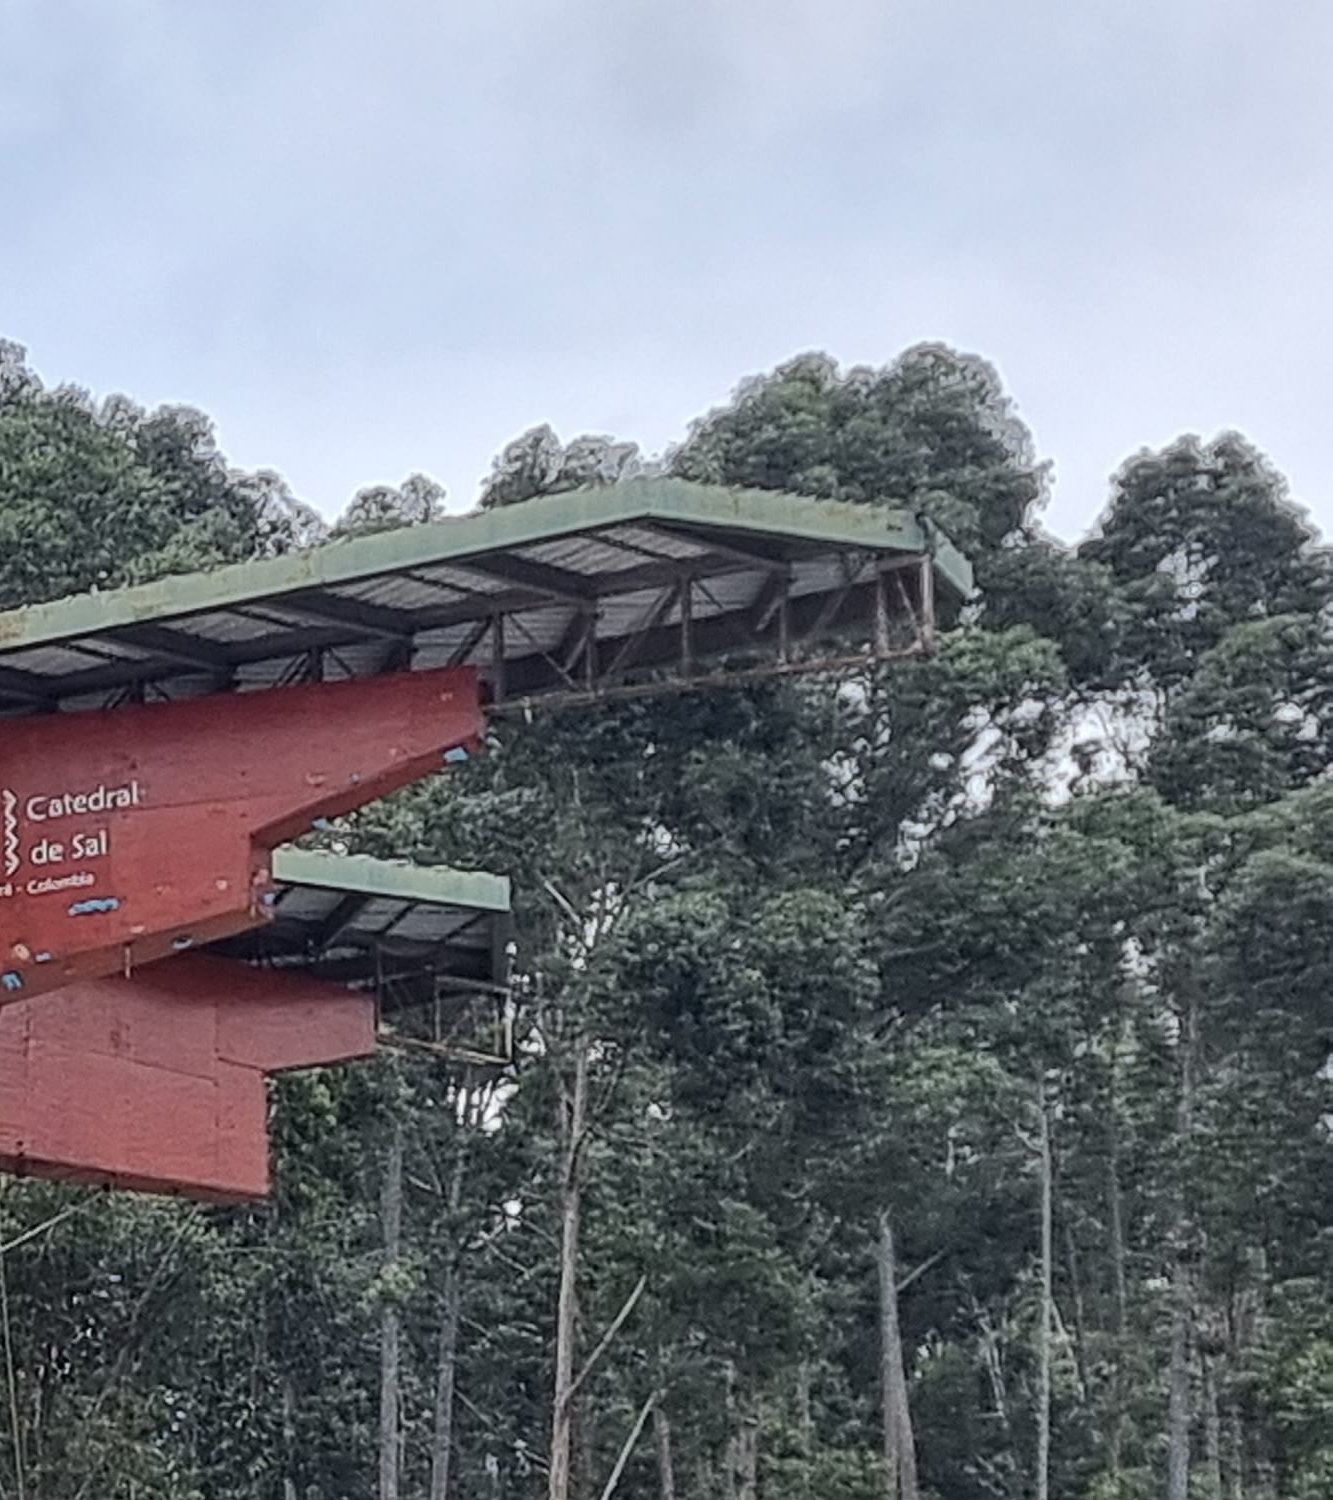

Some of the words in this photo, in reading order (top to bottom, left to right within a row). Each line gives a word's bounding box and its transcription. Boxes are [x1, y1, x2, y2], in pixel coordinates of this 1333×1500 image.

[26, 780, 140, 822] Catedral
[31, 839, 64, 865] de
[71, 829, 108, 860] Sal
